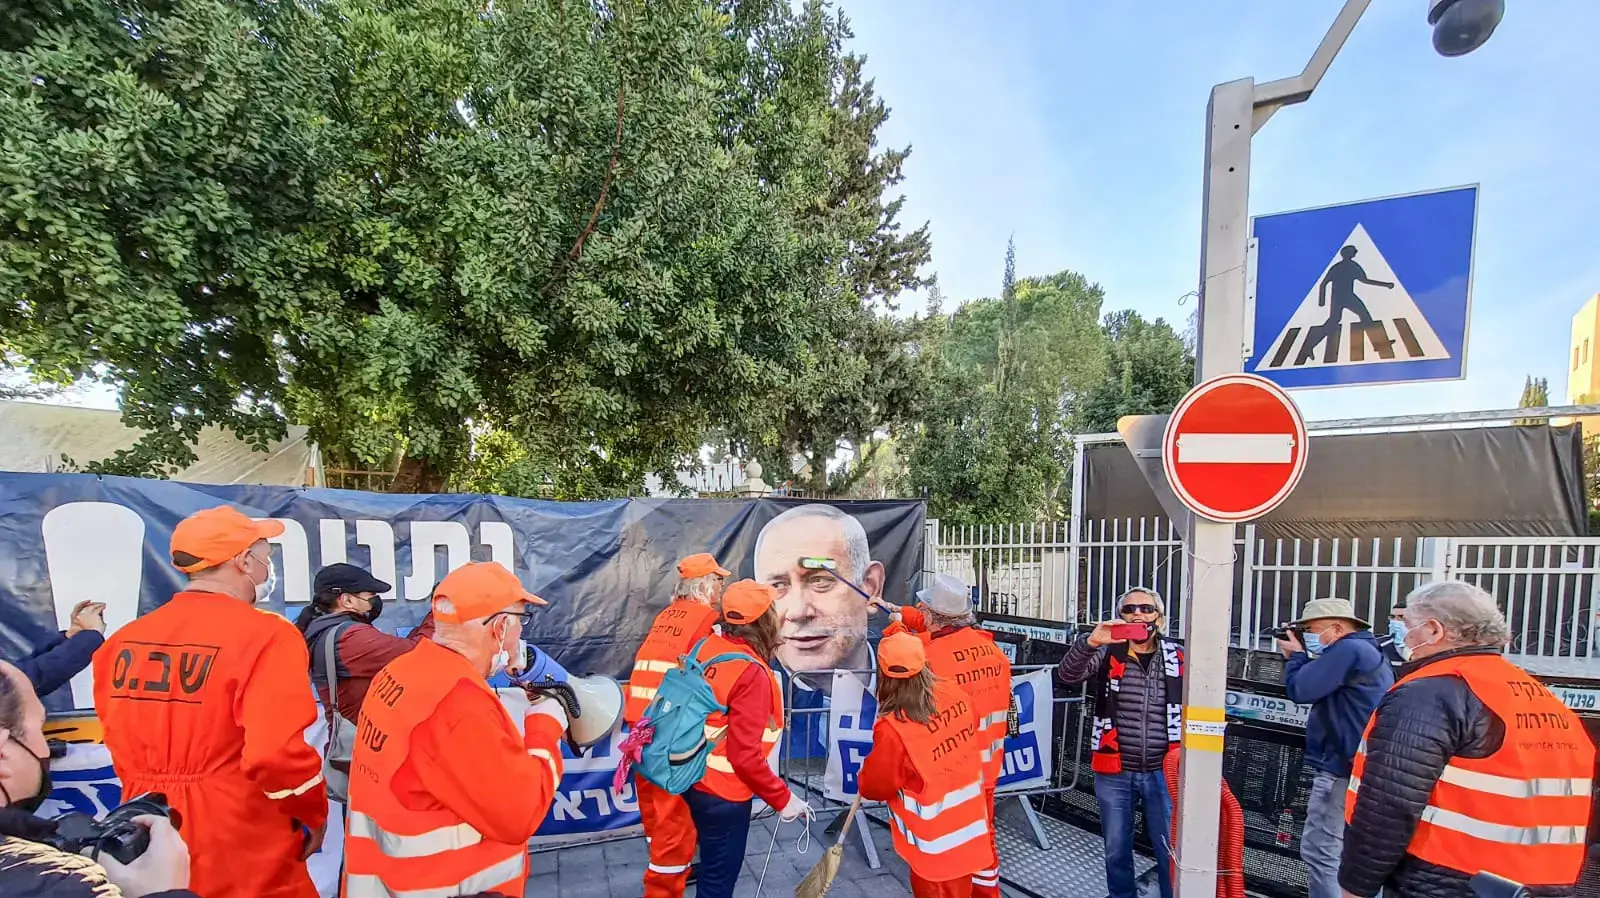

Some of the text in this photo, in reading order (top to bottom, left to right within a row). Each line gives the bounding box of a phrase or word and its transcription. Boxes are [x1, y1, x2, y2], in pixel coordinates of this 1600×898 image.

[952, 645, 993, 661] מנקים
[955, 664, 1001, 685] שחיתות
[926, 700, 968, 734] מנקים
[932, 722, 975, 762] שחיתות
[998, 746, 1036, 778] טו
[553, 782, 640, 821] שרא
